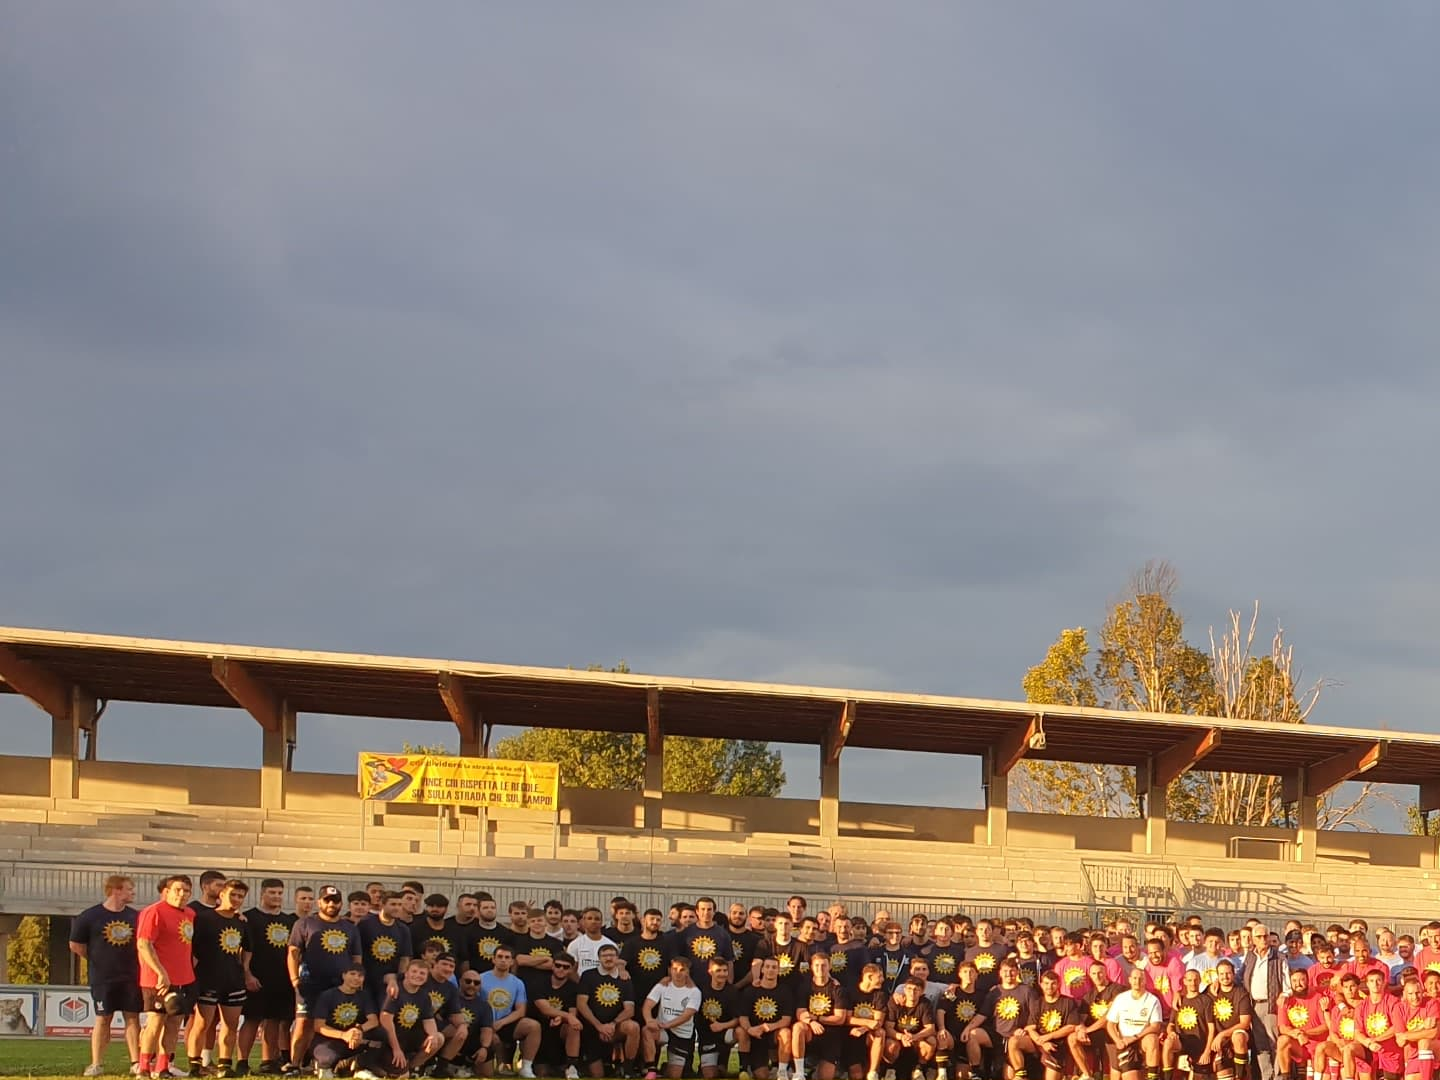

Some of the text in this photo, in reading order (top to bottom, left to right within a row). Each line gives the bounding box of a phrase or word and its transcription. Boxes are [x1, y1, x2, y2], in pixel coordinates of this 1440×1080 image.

[460, 779, 498, 790] RISPETTA
[427, 789, 452, 800] SULLA
[454, 791, 487, 802] STRADA
